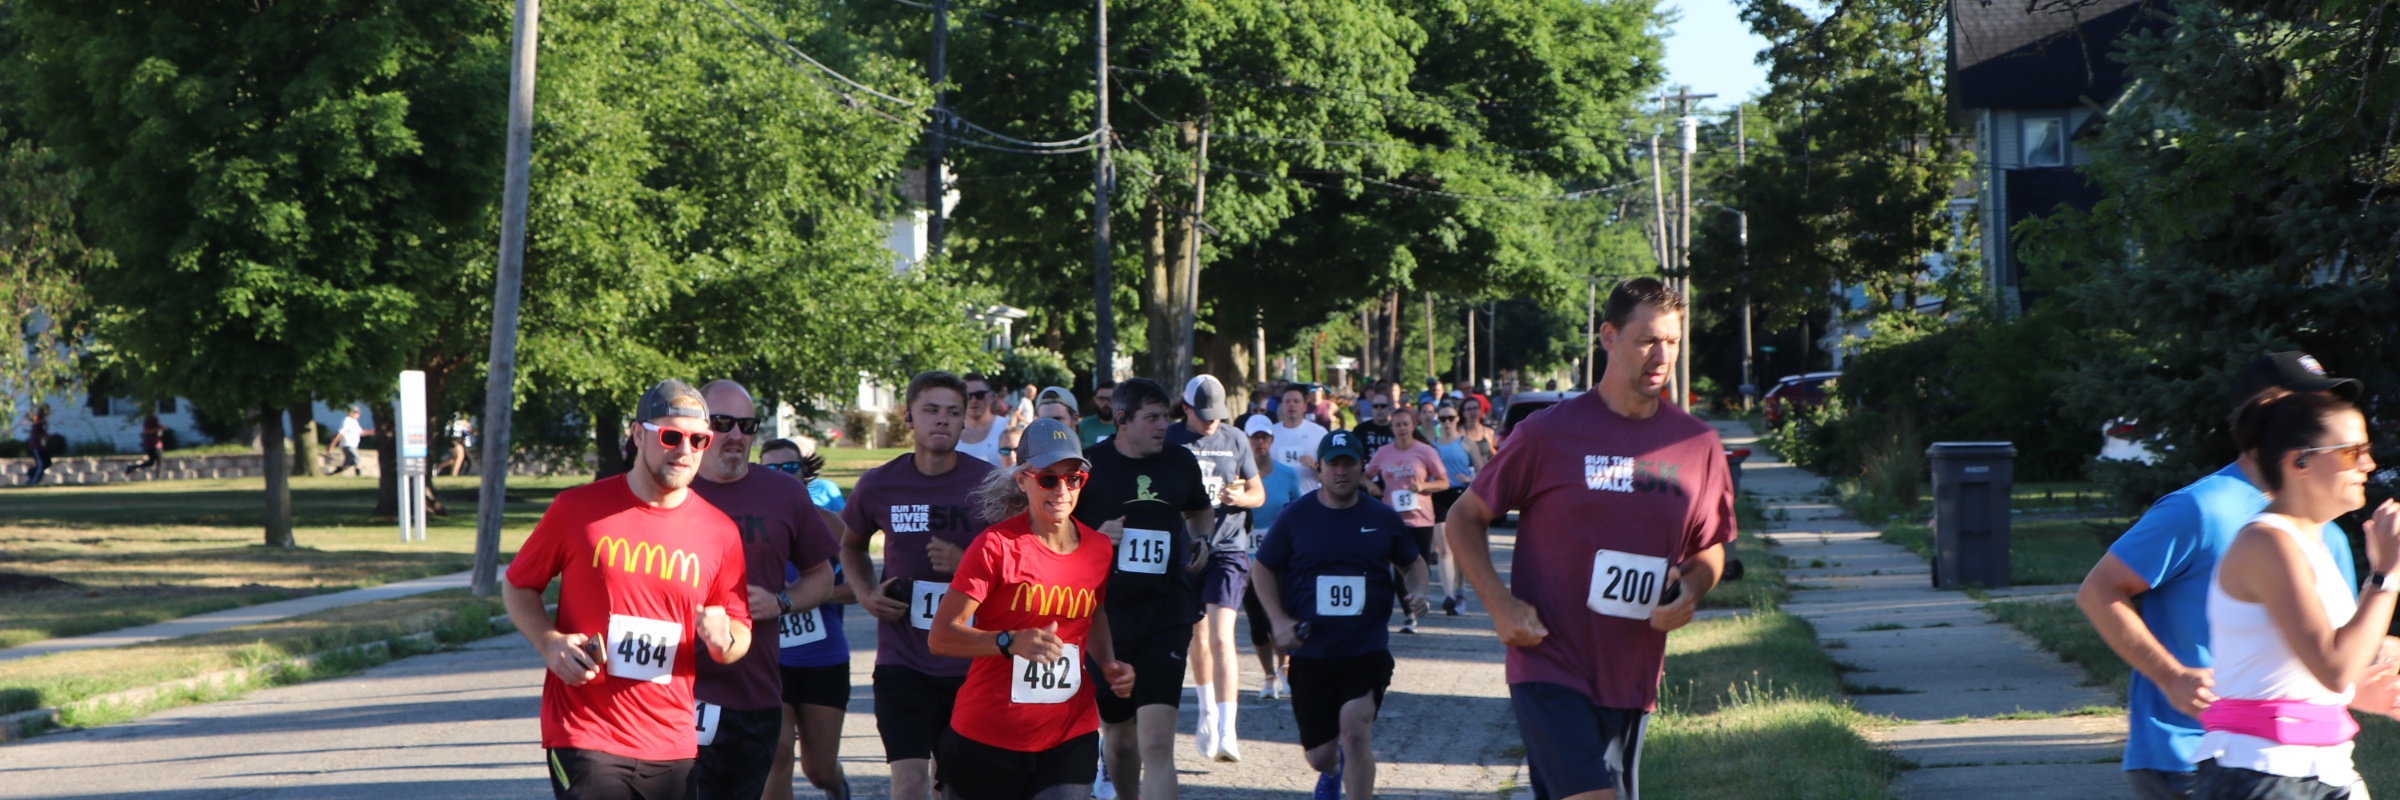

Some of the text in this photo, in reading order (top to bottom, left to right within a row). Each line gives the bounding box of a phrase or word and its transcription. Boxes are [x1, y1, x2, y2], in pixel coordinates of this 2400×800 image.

[1285, 450, 1298, 463] 94
[1585, 455, 1634, 466] RUN THE
[1585, 465, 1634, 478] RIVER
[1635, 460, 1684, 496] 5K
[1586, 477, 1634, 493] WALK
[891, 504, 929, 513] RUN THE
[1399, 493, 1412, 506] 93
[891, 512, 929, 523] RIVER
[930, 505, 973, 533] 5K
[891, 522, 930, 533] WALK
[1128, 538, 1164, 564] 115
[1602, 565, 1655, 605] 200
[1330, 585, 1353, 607] 99
[779, 610, 816, 638] 488
[617, 631, 667, 668] 484
[1023, 656, 1072, 689] 482
